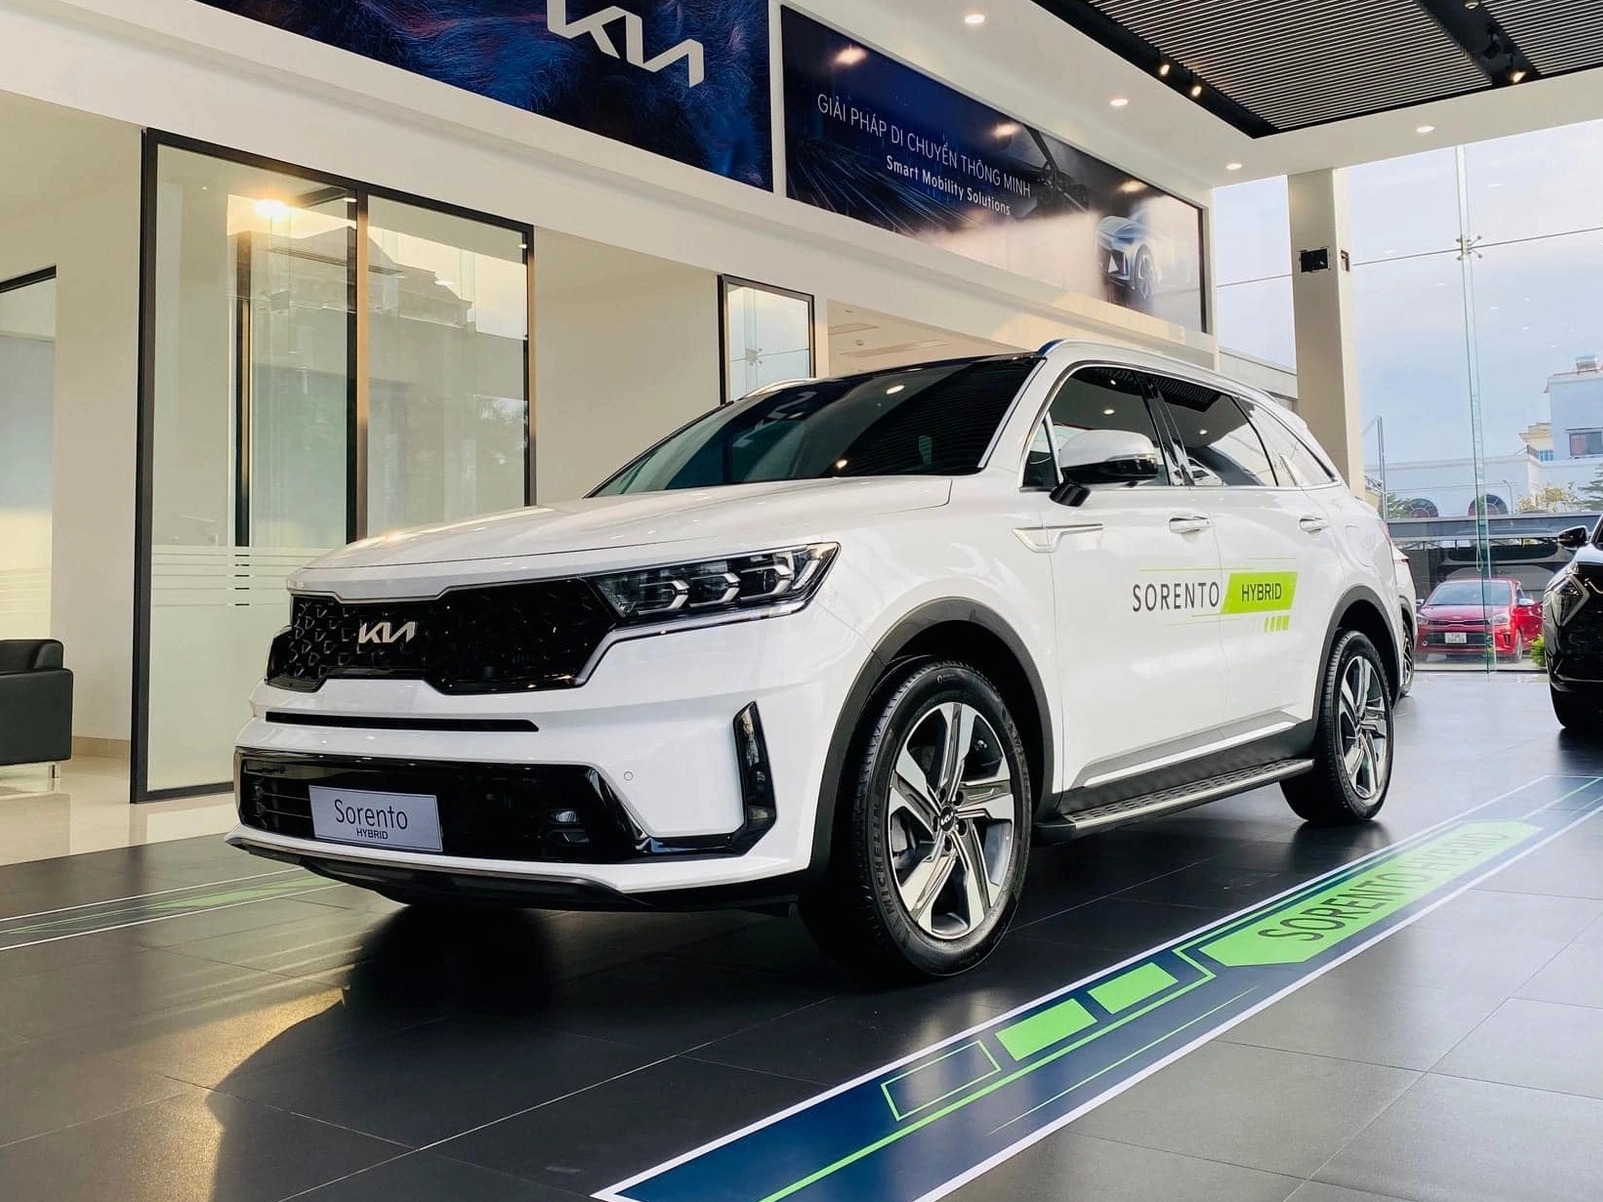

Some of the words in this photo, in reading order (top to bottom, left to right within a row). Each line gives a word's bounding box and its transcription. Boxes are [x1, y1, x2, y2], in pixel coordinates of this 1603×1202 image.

[817, 93, 846, 122] GIẢI
[850, 107, 887, 138] PHÁP
[891, 125, 903, 147] DI
[907, 132, 957, 168] CHUYỂN
[960, 154, 1001, 186] THÔNG
[1003, 172, 1031, 198] MINH
[886, 155, 919, 180] Smart
[922, 168, 964, 200] Mobility
[966, 187, 1011, 216] Solutions
[1132, 581, 1220, 612] SORENTO
[1241, 583, 1282, 602] HYBRID
[358, 621, 416, 644] KIA
[334, 799, 408, 830] Sorento
[356, 828, 389, 840] HYBRID
[1257, 872, 1433, 942] SORENTO
[1396, 833, 1508, 872] HYBRID
